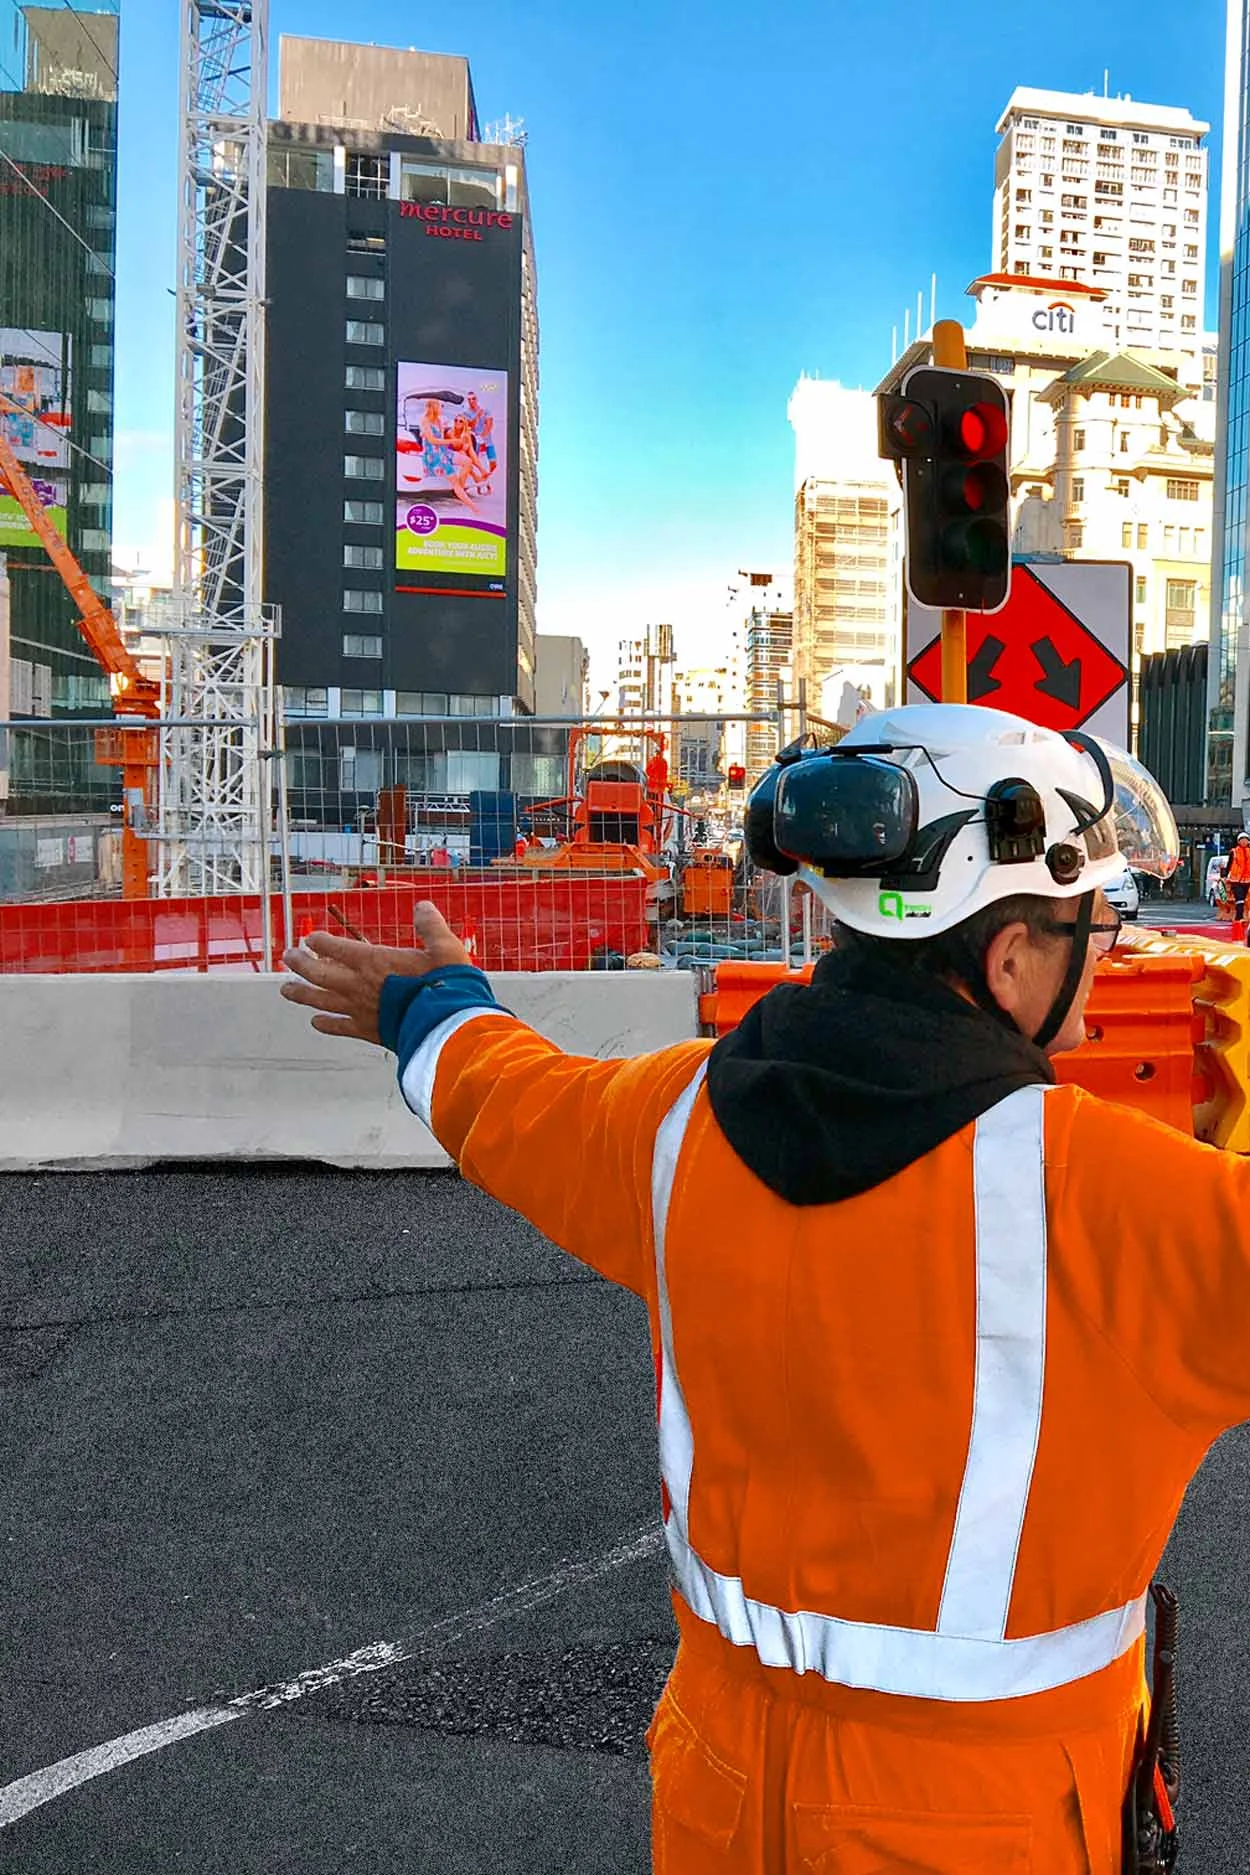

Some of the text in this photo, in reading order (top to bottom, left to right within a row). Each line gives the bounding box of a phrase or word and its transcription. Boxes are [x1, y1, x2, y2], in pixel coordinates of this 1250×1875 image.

[400, 199, 513, 229] mercure
[426, 225, 483, 240] HOTEL
[1032, 307, 1074, 333] citi
